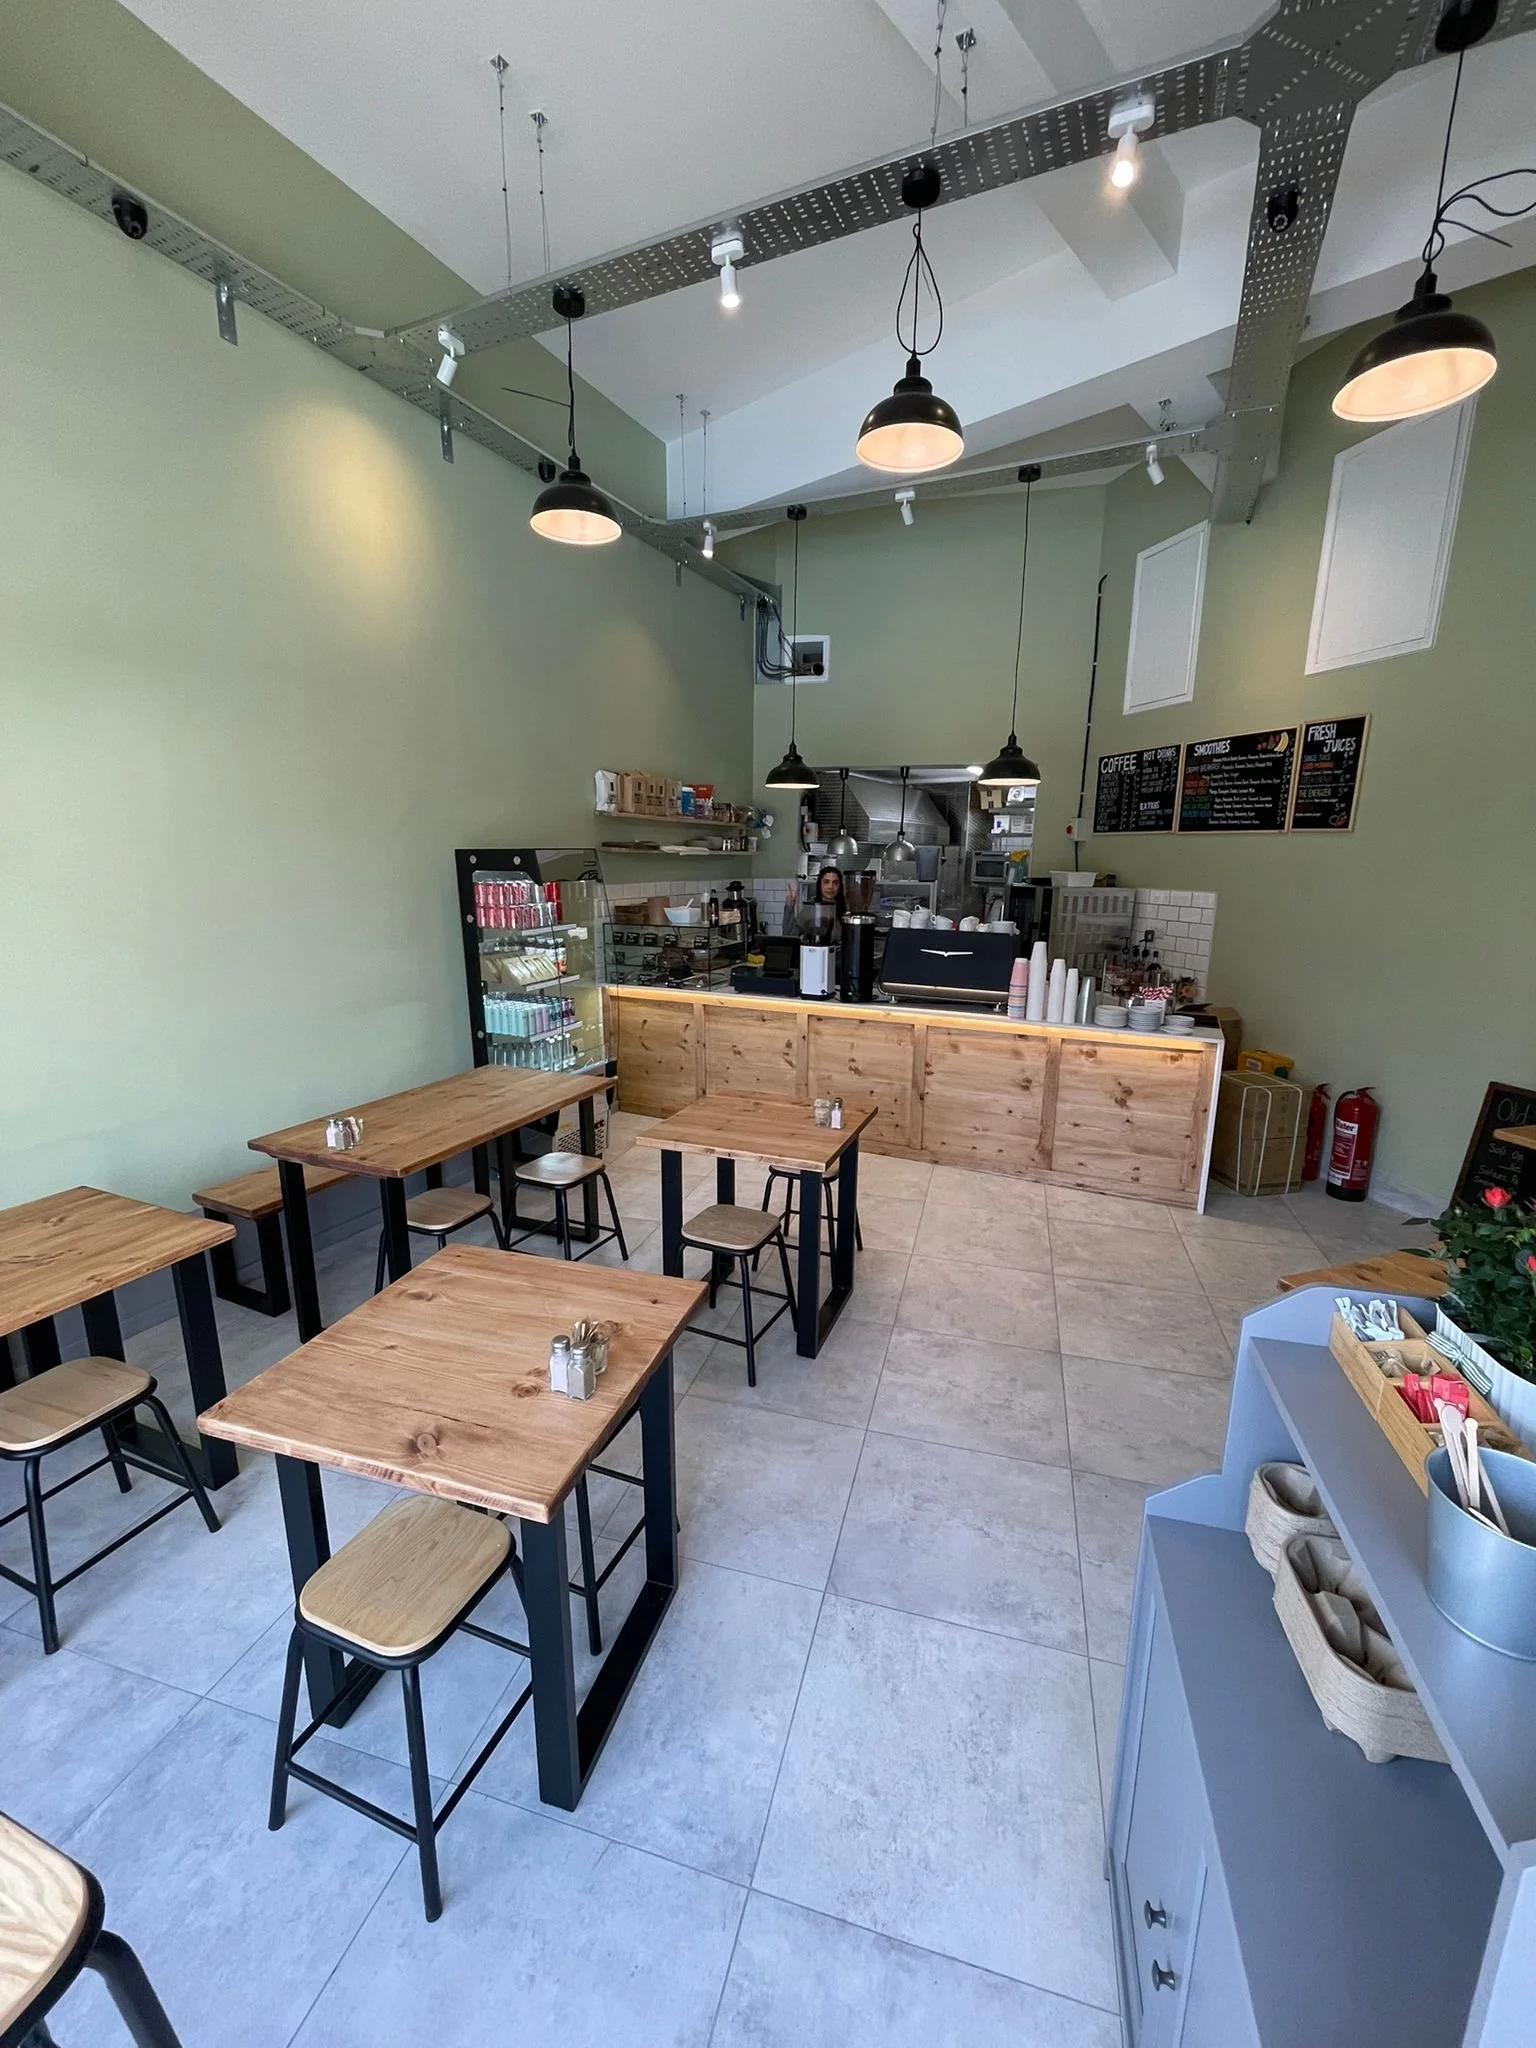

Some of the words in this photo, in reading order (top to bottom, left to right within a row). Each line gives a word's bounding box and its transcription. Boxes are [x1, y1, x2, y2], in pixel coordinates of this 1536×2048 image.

[1308, 723, 1337, 742] FRESH
[1194, 740, 1230, 756] SMOOTHIES
[1323, 737, 1356, 753] JUICES
[1102, 754, 1137, 773] COFFEE
[1143, 750, 1156, 761] HOT
[1497, 1097, 1530, 1125] Old
